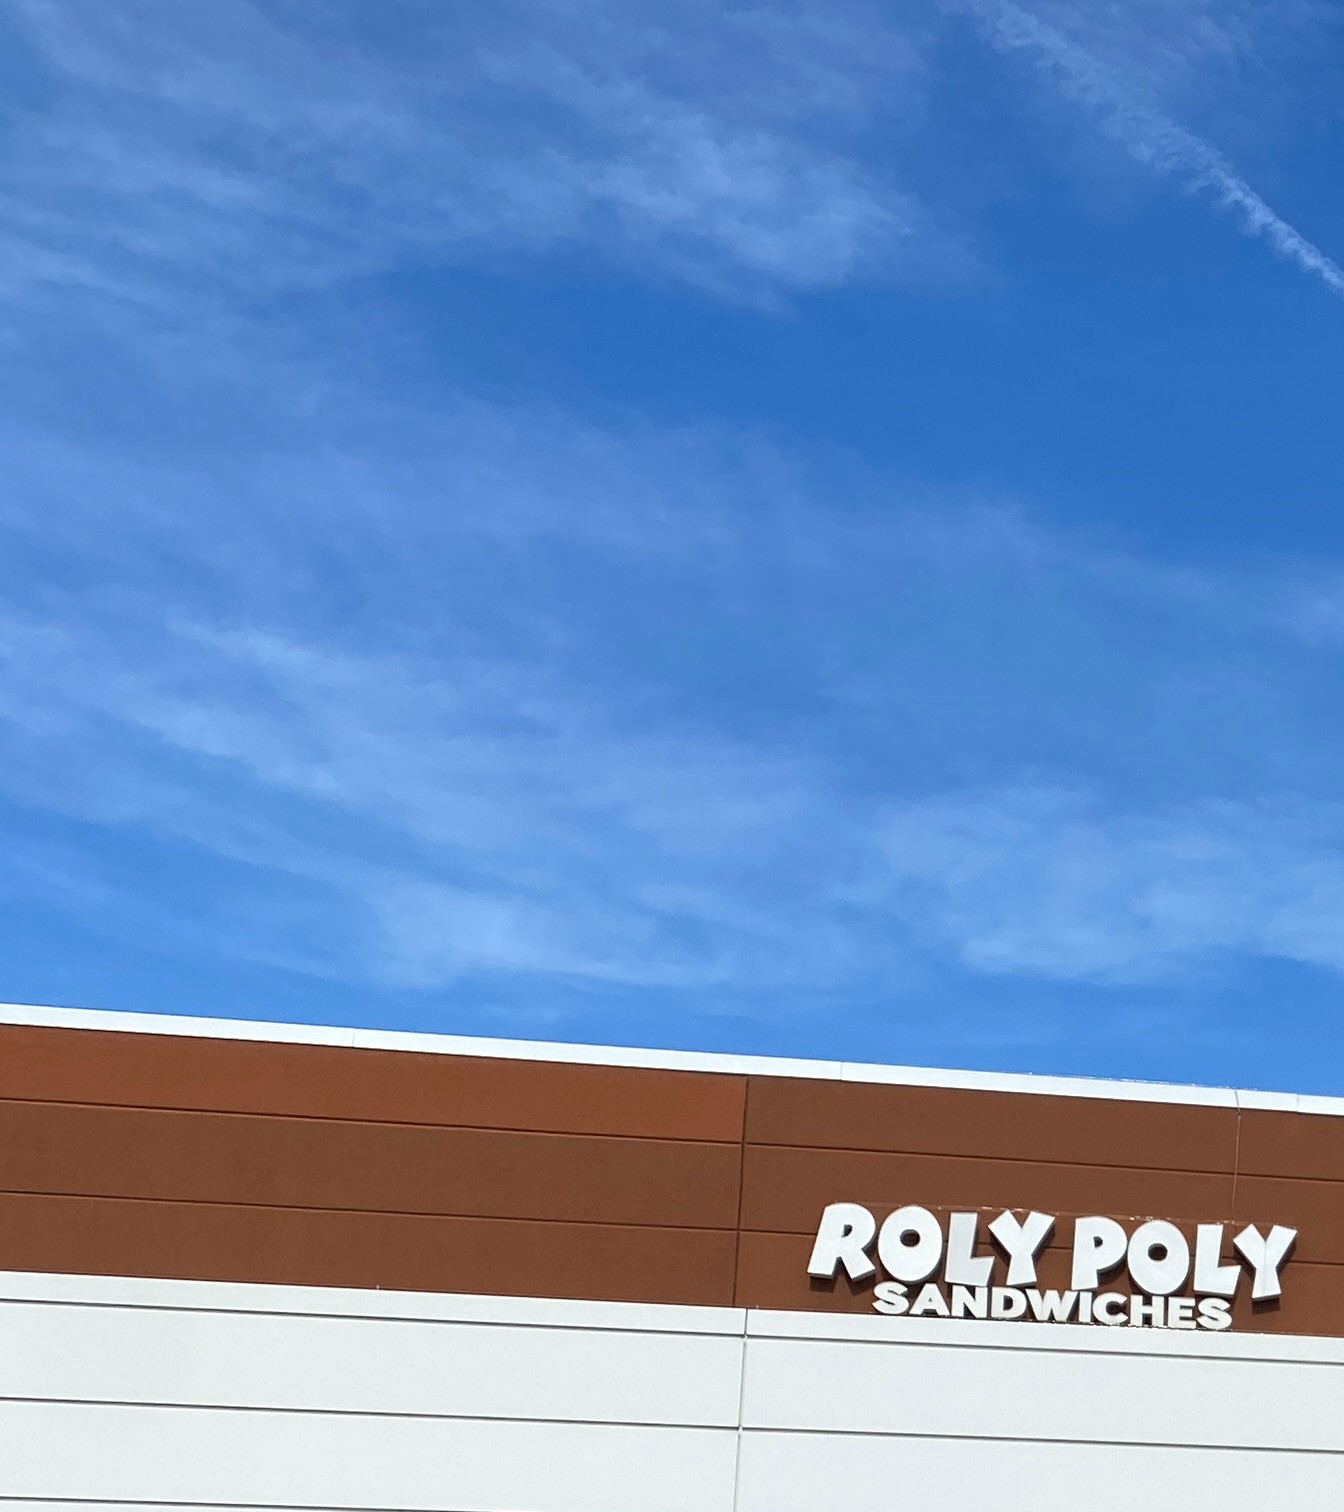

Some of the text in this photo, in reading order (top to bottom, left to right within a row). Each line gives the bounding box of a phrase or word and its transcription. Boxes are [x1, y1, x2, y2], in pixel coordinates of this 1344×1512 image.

[807, 1202, 1298, 1299] ROLY POLY
[872, 1280, 1232, 1330] SANDWICHES
